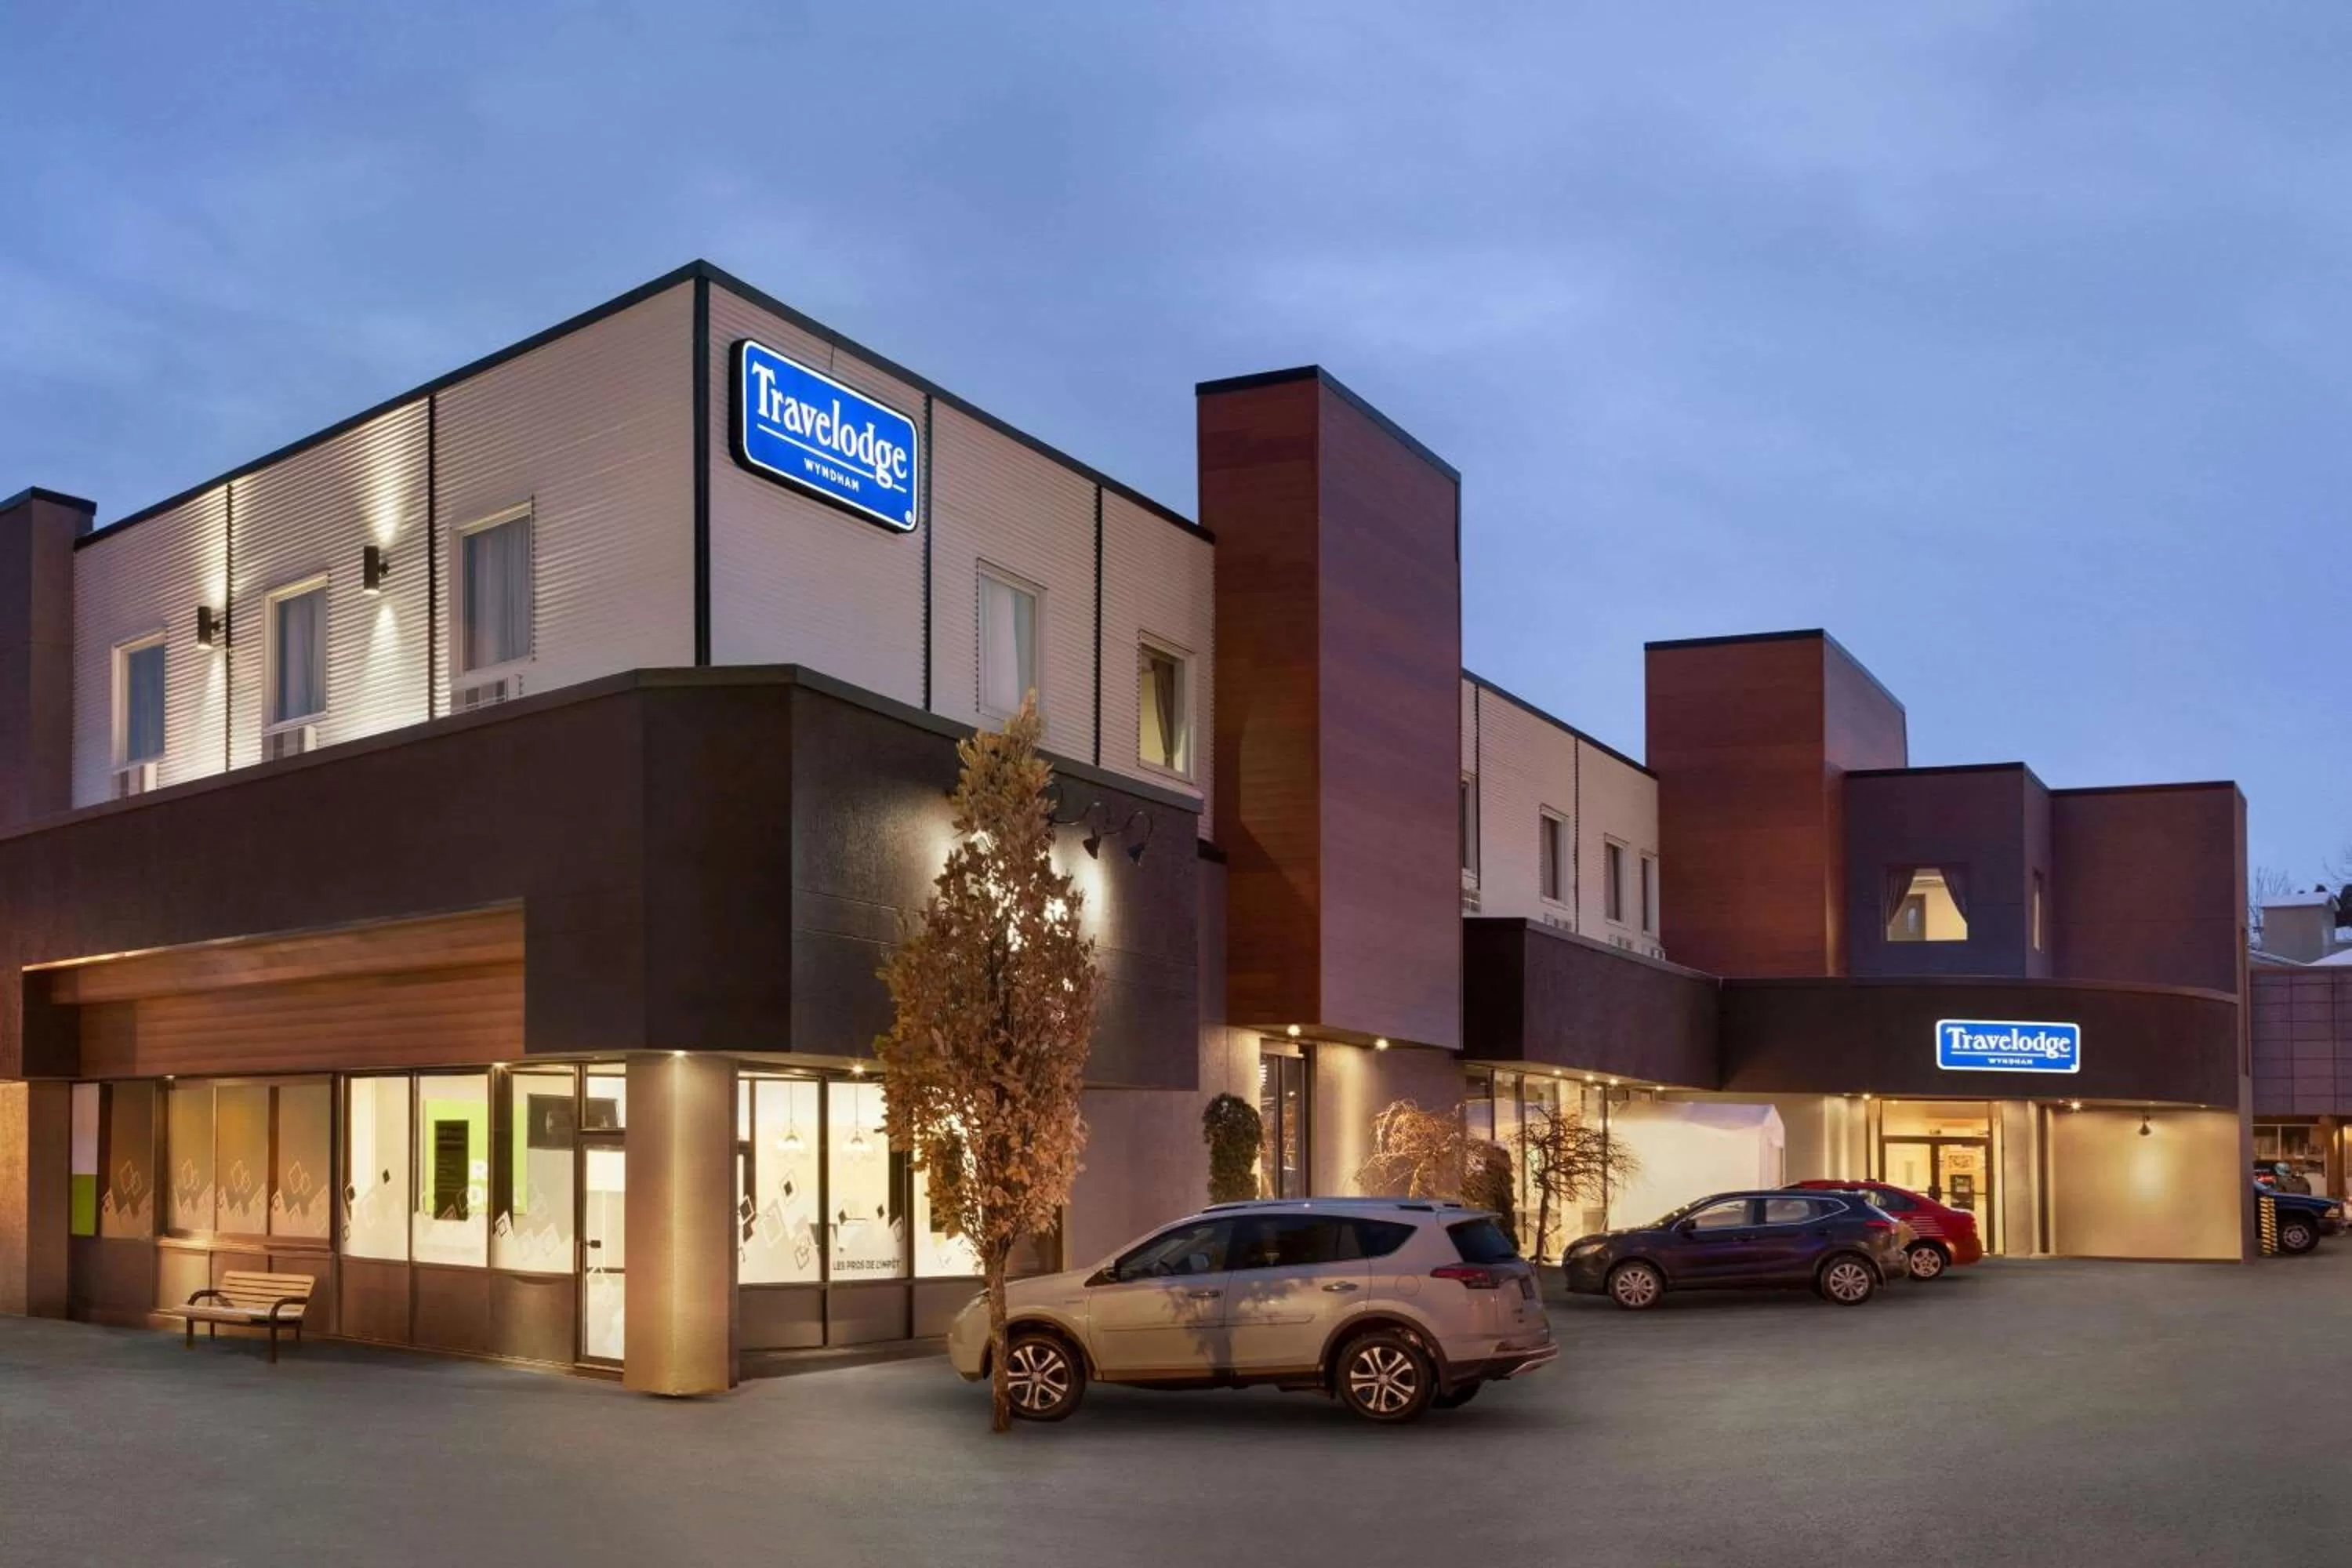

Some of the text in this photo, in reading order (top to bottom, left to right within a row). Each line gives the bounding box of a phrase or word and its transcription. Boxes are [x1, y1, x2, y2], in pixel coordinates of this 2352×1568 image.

[752, 361, 907, 489] Travelodge
[804, 458, 859, 492] WYNDHAM
[1946, 1027, 2071, 1059] Travelodge
